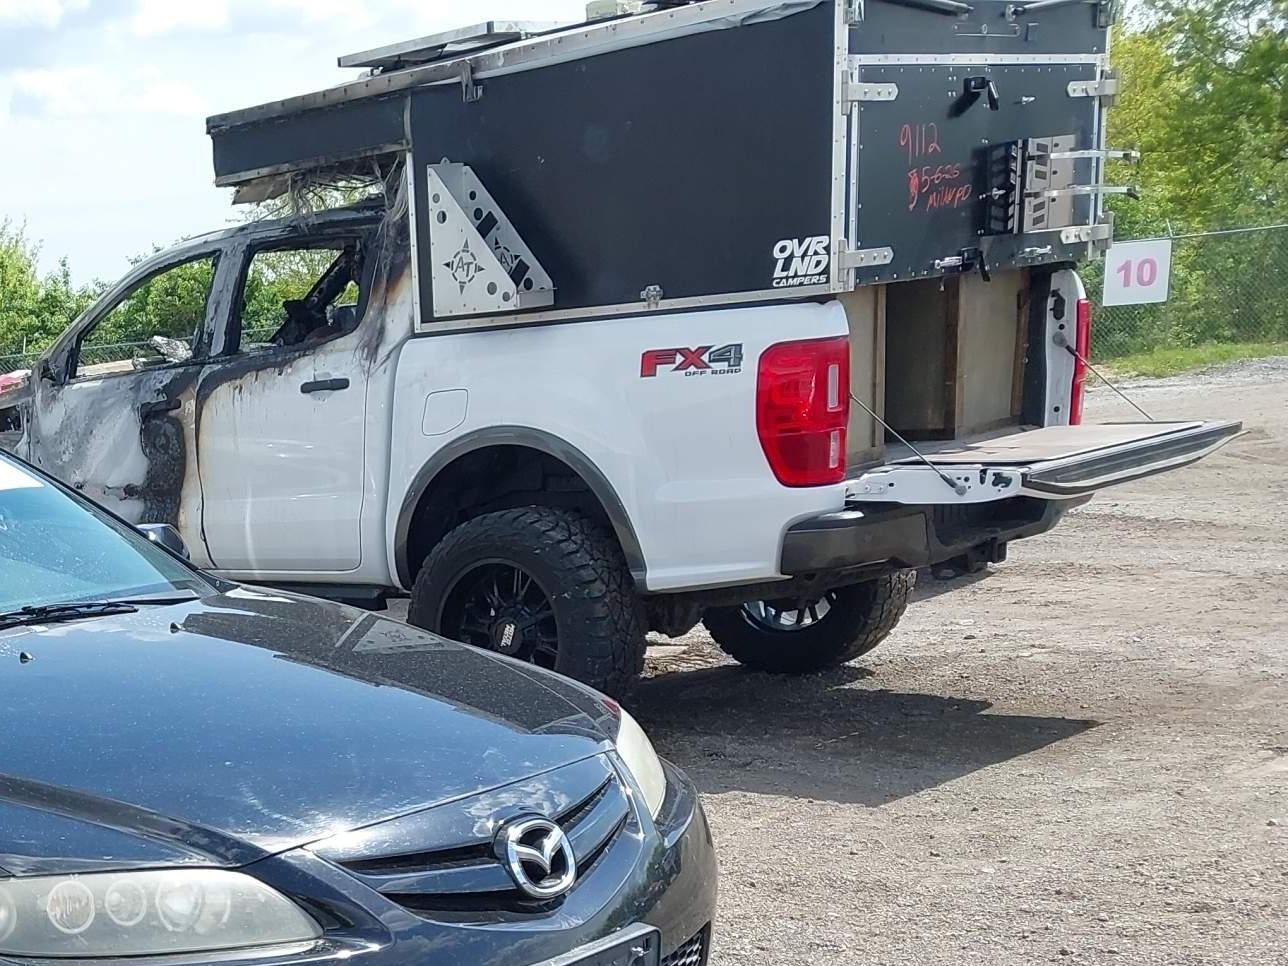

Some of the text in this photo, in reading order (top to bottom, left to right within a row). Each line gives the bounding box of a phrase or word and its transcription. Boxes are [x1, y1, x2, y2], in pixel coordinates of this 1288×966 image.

[900, 121, 942, 165] 9112
[773, 235, 830, 259] OVR
[454, 255, 474, 278] AT
[773, 254, 829, 278] LND
[1116, 257, 1158, 288] 10
[772, 274, 828, 287] CAMPERS
[639, 343, 744, 378] FX4
[711, 367, 742, 375] ROAD
